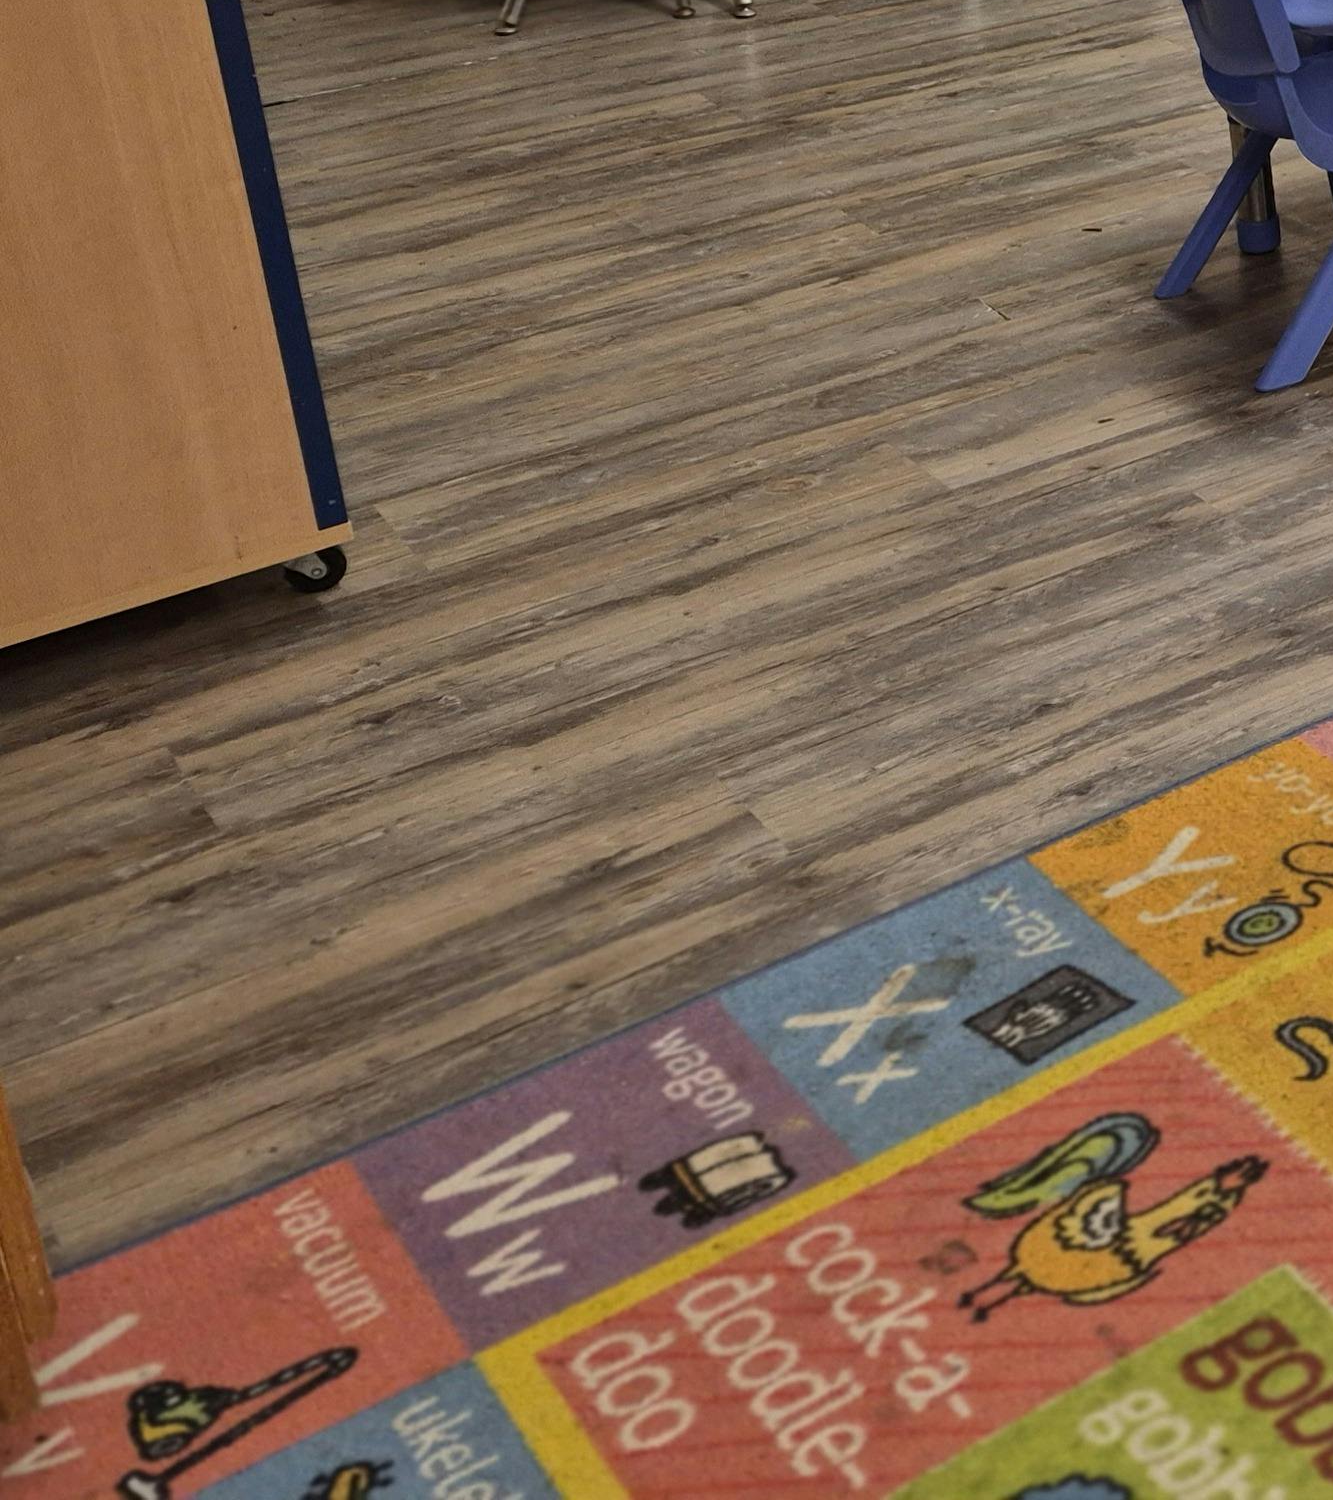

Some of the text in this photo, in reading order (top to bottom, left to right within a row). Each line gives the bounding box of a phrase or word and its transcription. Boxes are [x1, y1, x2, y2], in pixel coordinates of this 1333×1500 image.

[980, 886, 1073, 958] x-ray
[648, 1026, 753, 1131] wagon
[273, 1187, 388, 1335] vacuum
[570, 1330, 693, 1451] doo
[676, 1273, 868, 1488] doodle-
